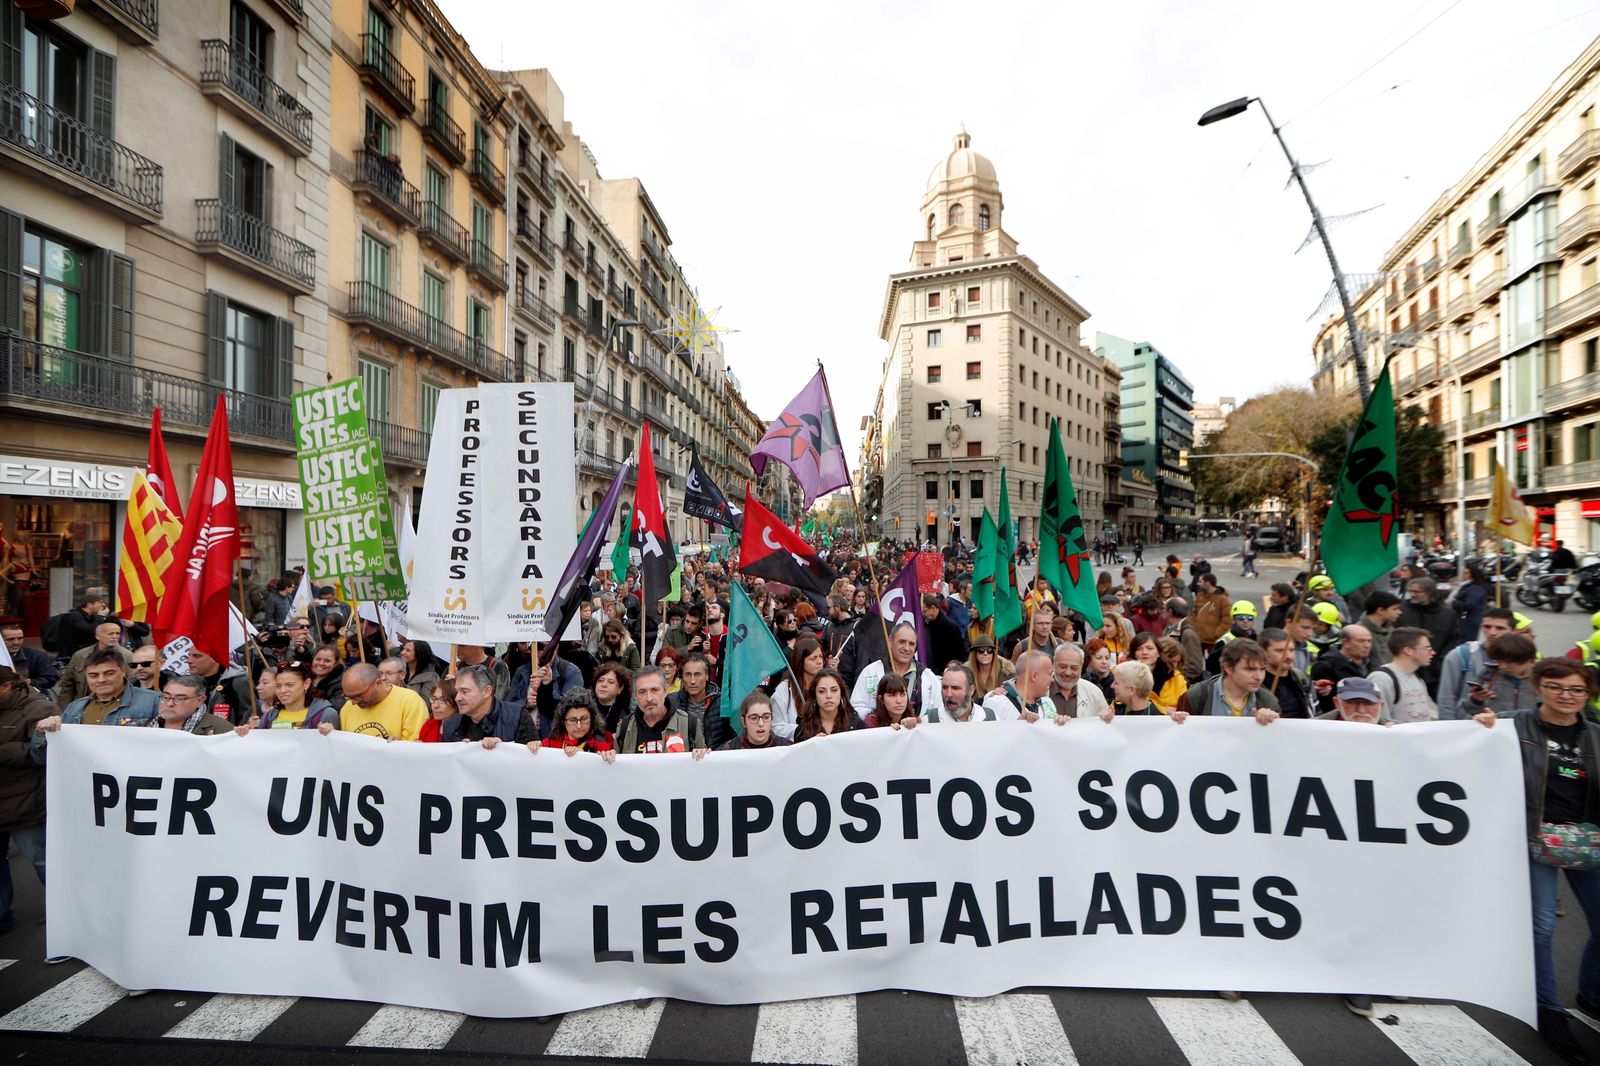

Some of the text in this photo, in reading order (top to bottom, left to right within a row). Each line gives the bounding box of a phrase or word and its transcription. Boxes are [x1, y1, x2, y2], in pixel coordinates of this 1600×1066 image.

[296, 381, 361, 425] USTEC
[352, 427, 366, 440] IAC
[302, 445, 370, 487] USTEC
[517, 391, 543, 579] SECUNDÀRIA
[360, 491, 374, 503] IAC
[449, 400, 481, 580] PROFESSORS
[309, 510, 377, 549] USTEC
[368, 556, 382, 567] IAC
[451, 613, 480, 621] Professors
[93, 770, 1470, 863] PER UNS PRESSUPOSTOS SOCIALS
[189, 872, 1302, 969] REVERTIM LES RETALLADES
